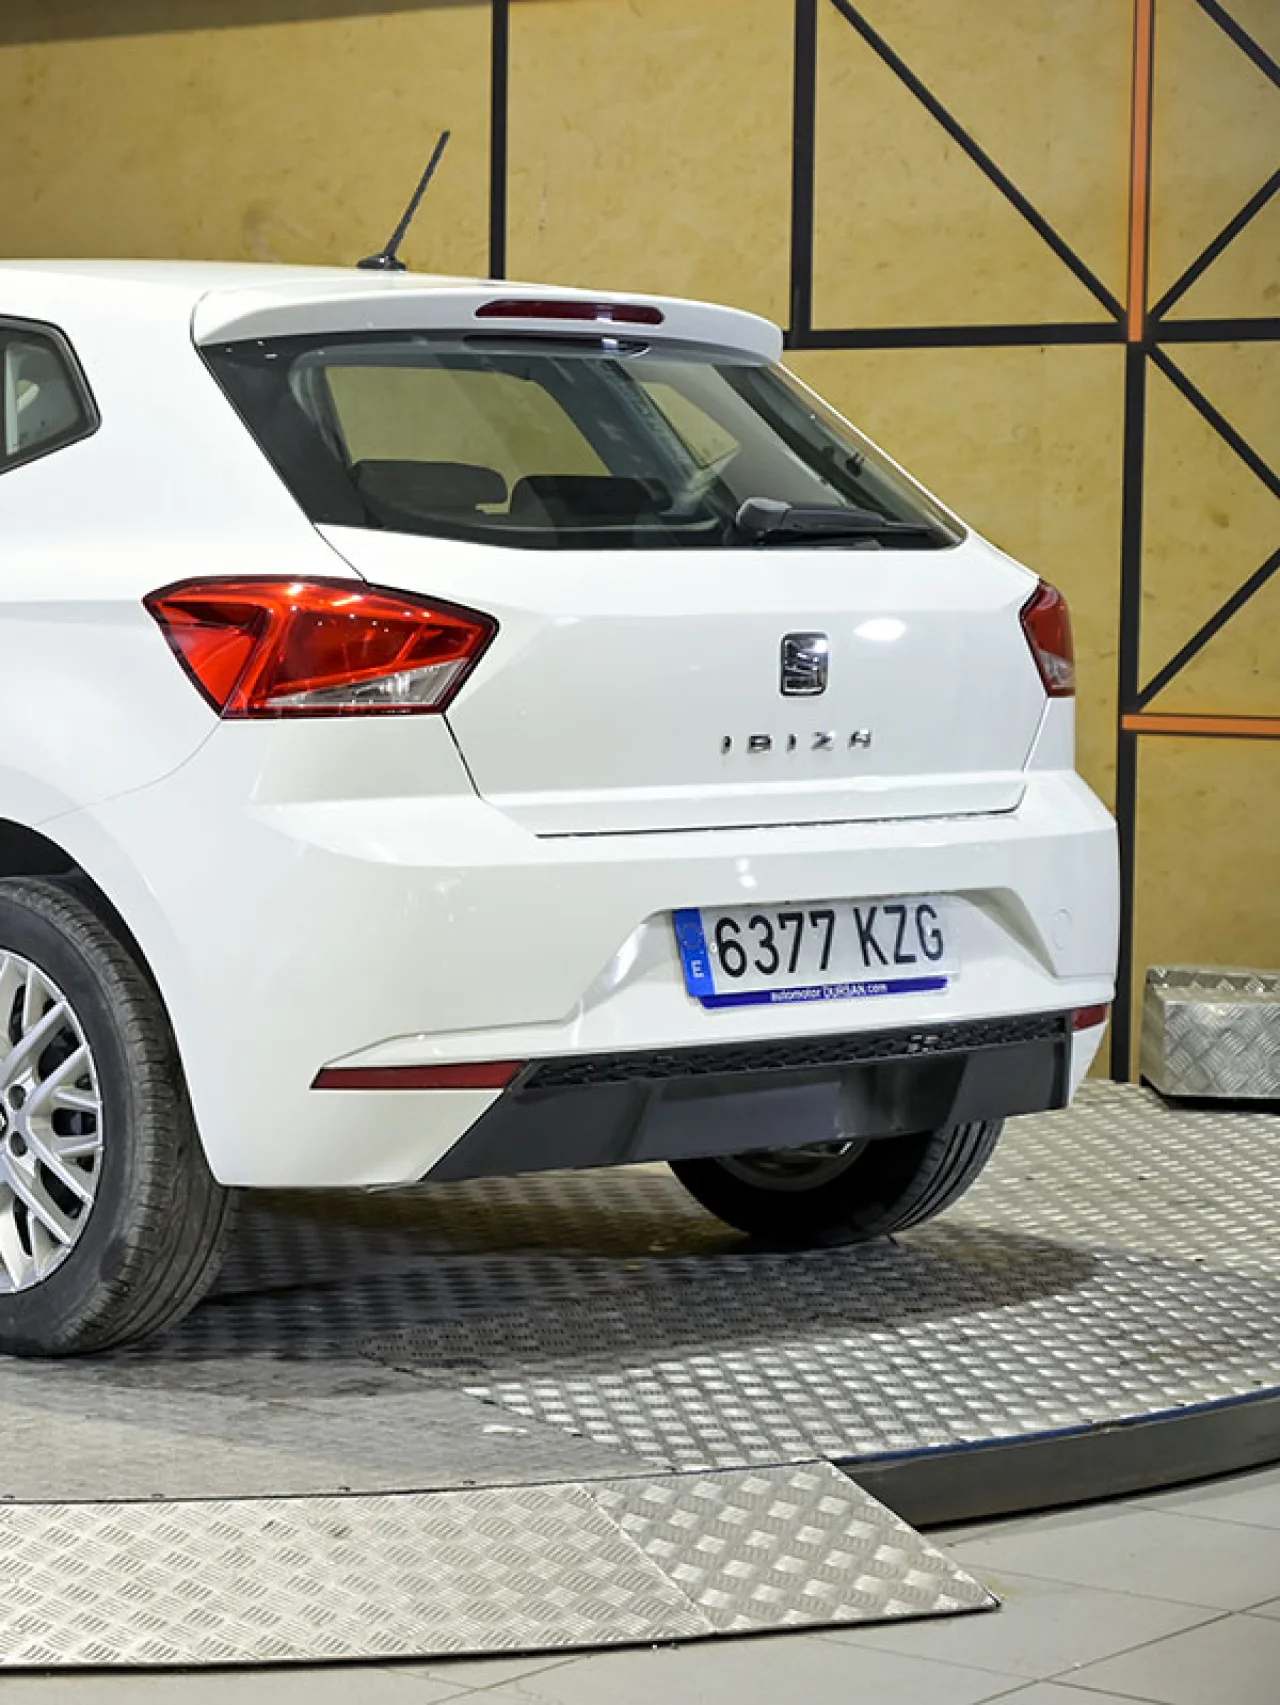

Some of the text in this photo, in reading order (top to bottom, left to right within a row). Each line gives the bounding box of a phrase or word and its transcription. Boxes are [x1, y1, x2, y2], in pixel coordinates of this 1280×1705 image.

[720, 730, 872, 754] IBIZA
[691, 904, 943, 977] E 6377 KZG
[771, 988, 821, 1002] automotor
